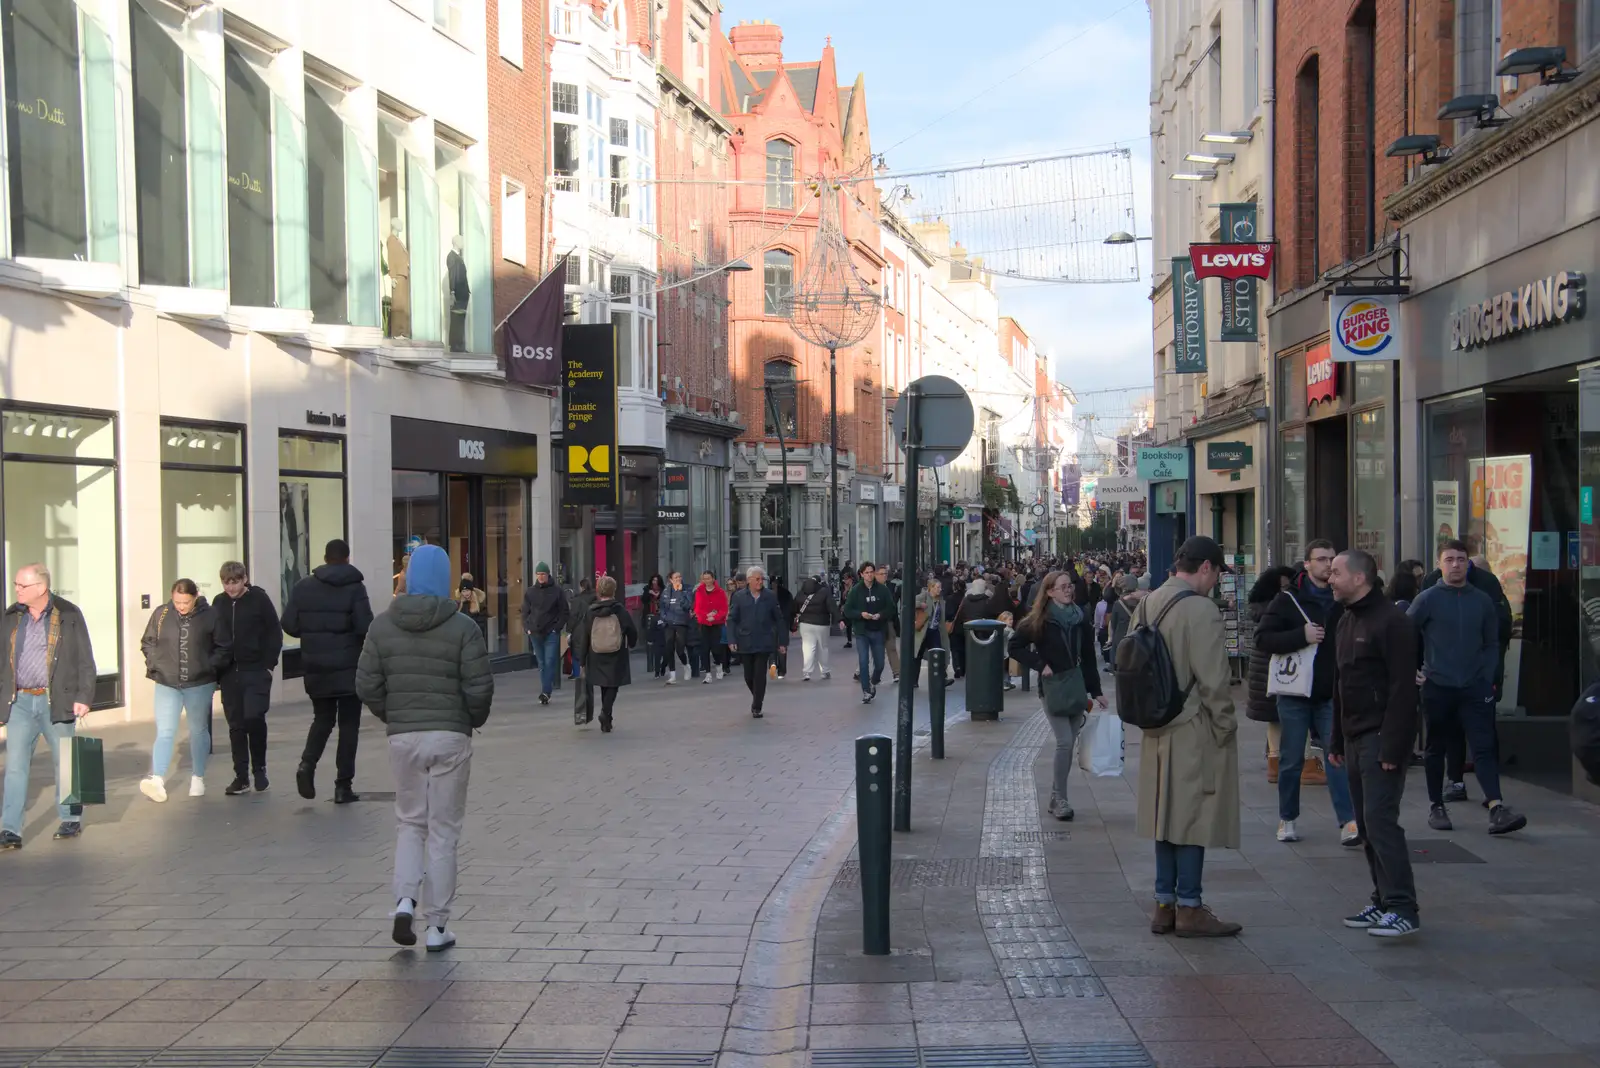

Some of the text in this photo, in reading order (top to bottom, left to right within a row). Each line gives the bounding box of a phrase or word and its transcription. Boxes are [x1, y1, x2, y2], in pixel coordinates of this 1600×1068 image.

[1224, 304, 1232, 327] GIFTS
[1450, 271, 1572, 352] BURGER KING
[1343, 308, 1388, 331] BURGER
[1345, 318, 1390, 345] KING
[512, 344, 554, 361] BOSS
[568, 361, 583, 369] The
[568, 370, 604, 380] Academy
[568, 403, 597, 411] Lunatic
[568, 413, 593, 423] Fringe
[458, 439, 485, 460] BOSS
[1142, 451, 1184, 461] Bookshop
[1153, 469, 1173, 478] Café
[1476, 462, 1523, 489] BIG
[657, 510, 686, 518] Dune
